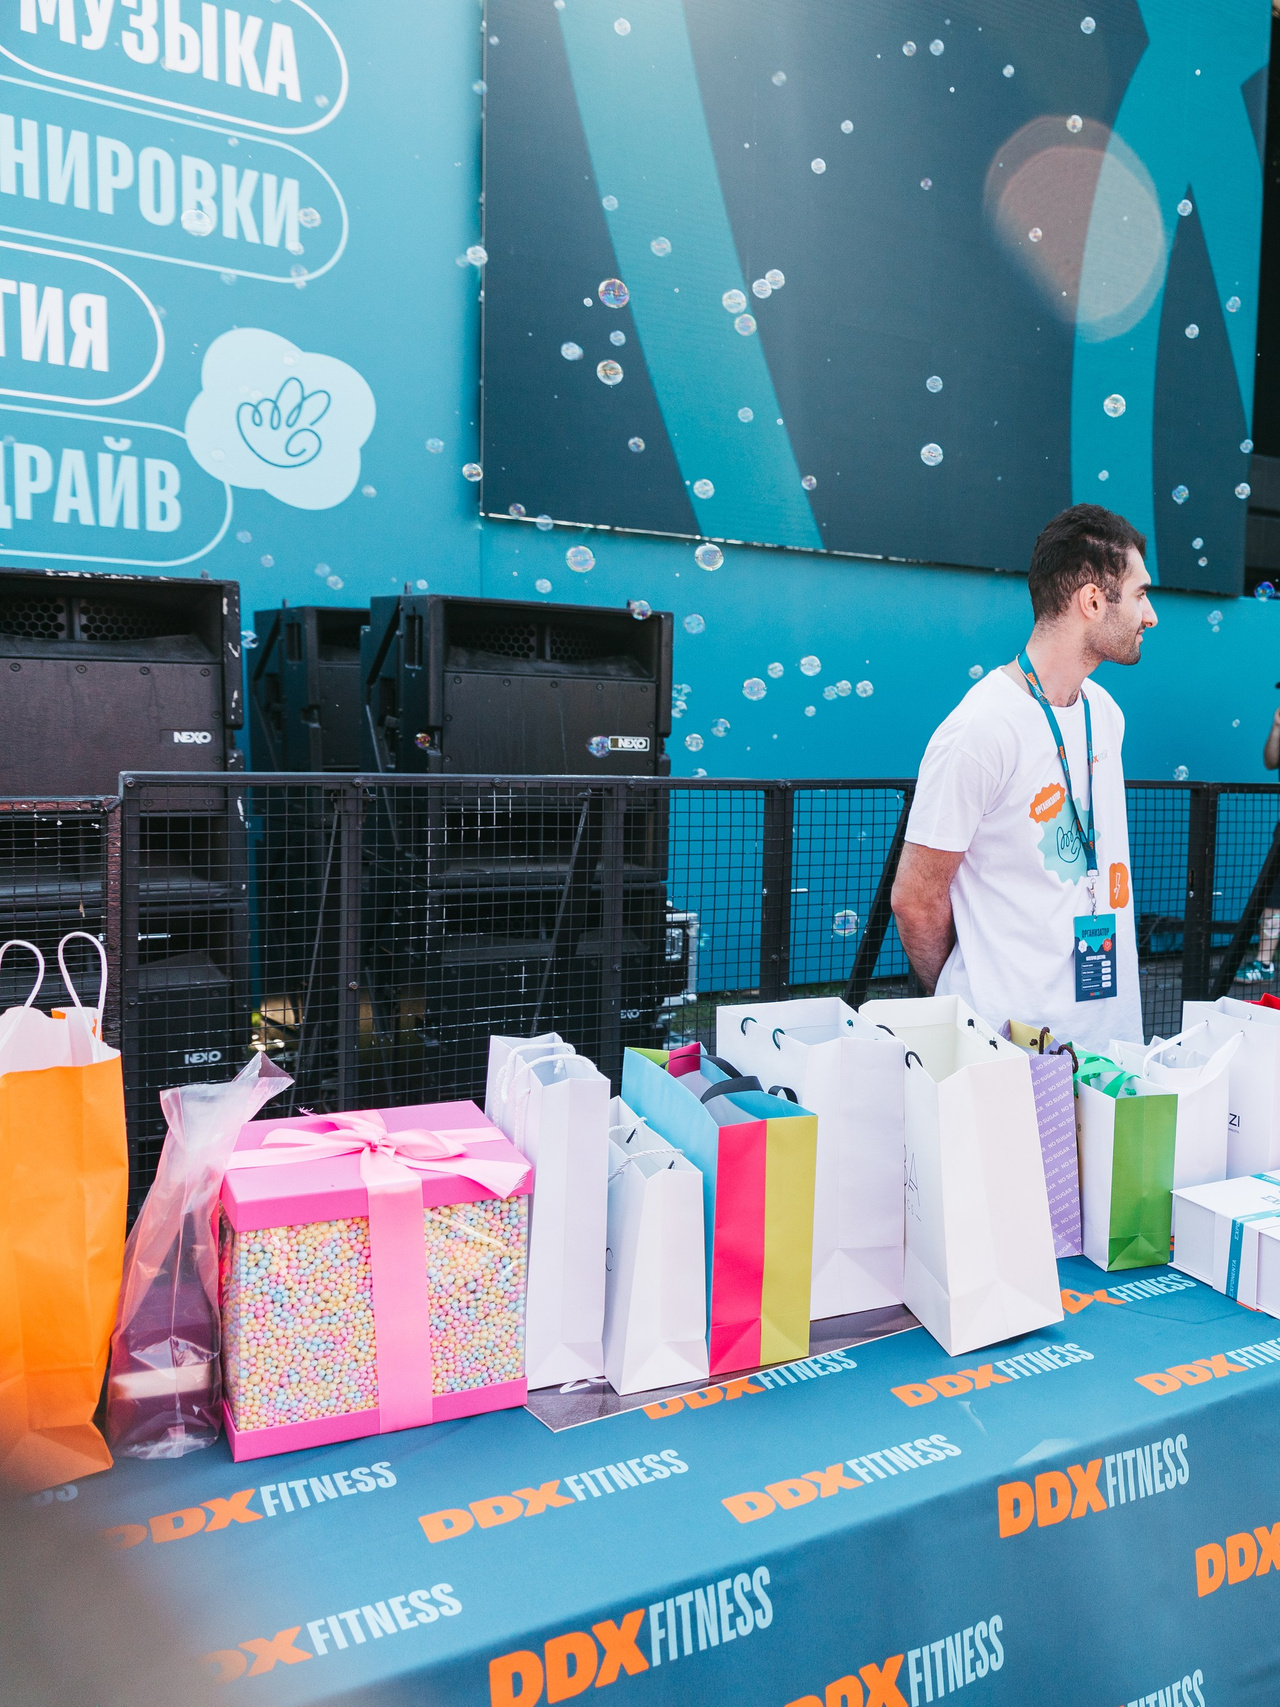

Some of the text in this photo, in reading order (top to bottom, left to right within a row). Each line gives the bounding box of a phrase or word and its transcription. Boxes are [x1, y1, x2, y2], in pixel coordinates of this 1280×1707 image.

[173, 731, 211, 744] NEXO
[618, 738, 646, 749] NEXO
[1082, 927, 1110, 938] ОРГАНИЗАТОР
[1044, 1055, 1060, 1066] SUGAR
[1033, 1079, 1040, 1087] NO
[1040, 1070, 1056, 1081] SUGAR
[1056, 1076, 1073, 1086] SUGAR
[1053, 1090, 1070, 1102] SUGAR
[1042, 1112, 1059, 1123] SUGAR
[1040, 1127, 1057, 1138] SUGAR
[1056, 1132, 1073, 1143] SUGAR
[1045, 1146, 1070, 1164] NO SUGAR
[1056, 1188, 1073, 1199] SUGAR
[1052, 1203, 1069, 1215] SUGAR
[1057, 1242, 1072, 1257] SUGAR
[1062, 1273, 1197, 1315] DXFITNESS
[890, 1343, 1094, 1407] DDXFITNESS
[720, 1434, 962, 1524] DDXFITNESS
[998, 1434, 1190, 1539] DDXFITNESS
[418, 1449, 690, 1543] DDXFITNESS
[488, 1567, 773, 1707] DDXFITNESS
[784, 1615, 1005, 1707] XFITNESS
